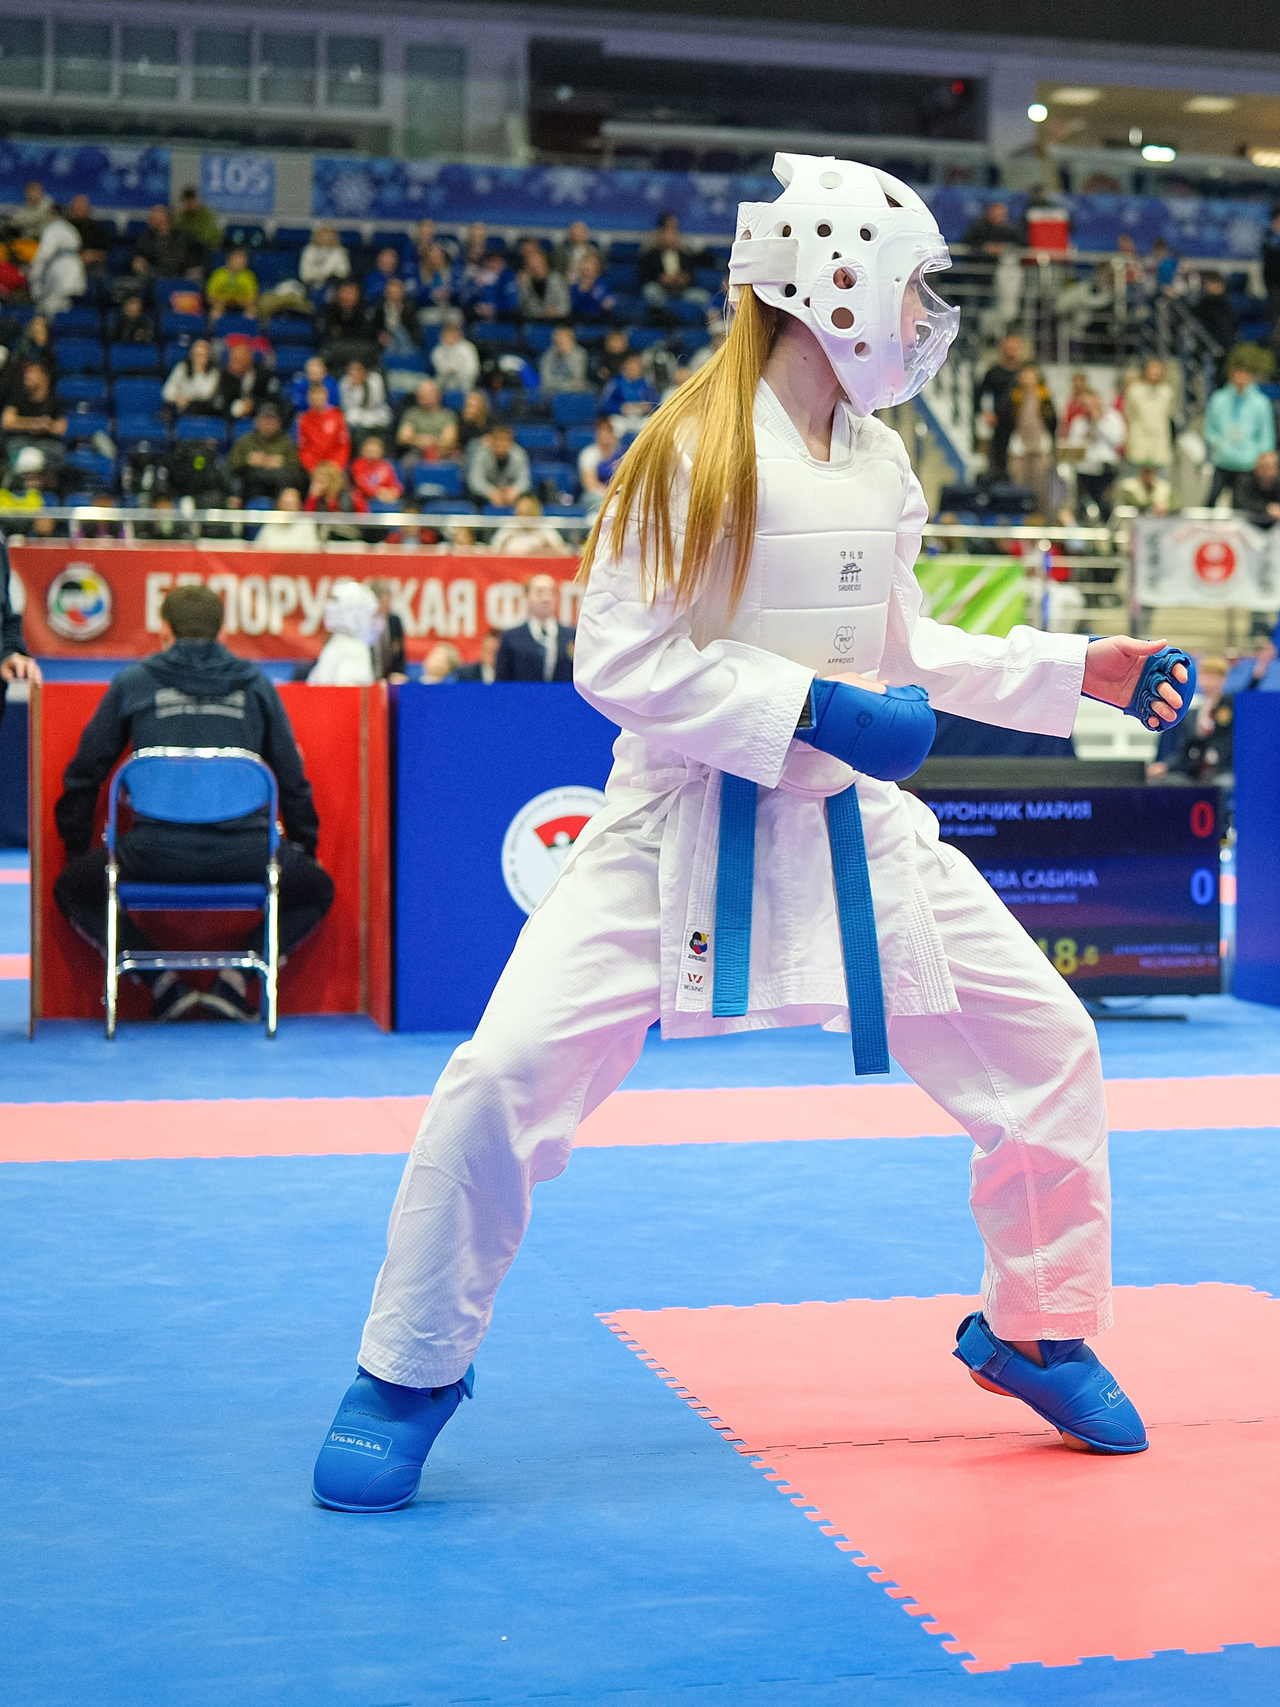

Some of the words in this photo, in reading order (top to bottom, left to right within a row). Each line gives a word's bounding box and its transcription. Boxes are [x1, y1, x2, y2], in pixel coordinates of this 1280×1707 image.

[211, 157, 270, 195] 105
[1025, 800, 1092, 820] МАРИЯ
[1190, 801, 1214, 838] 0
[1022, 868, 1098, 889] САБИНА
[1190, 867, 1215, 905] 0
[357, 1411, 399, 1426] APPROVED
